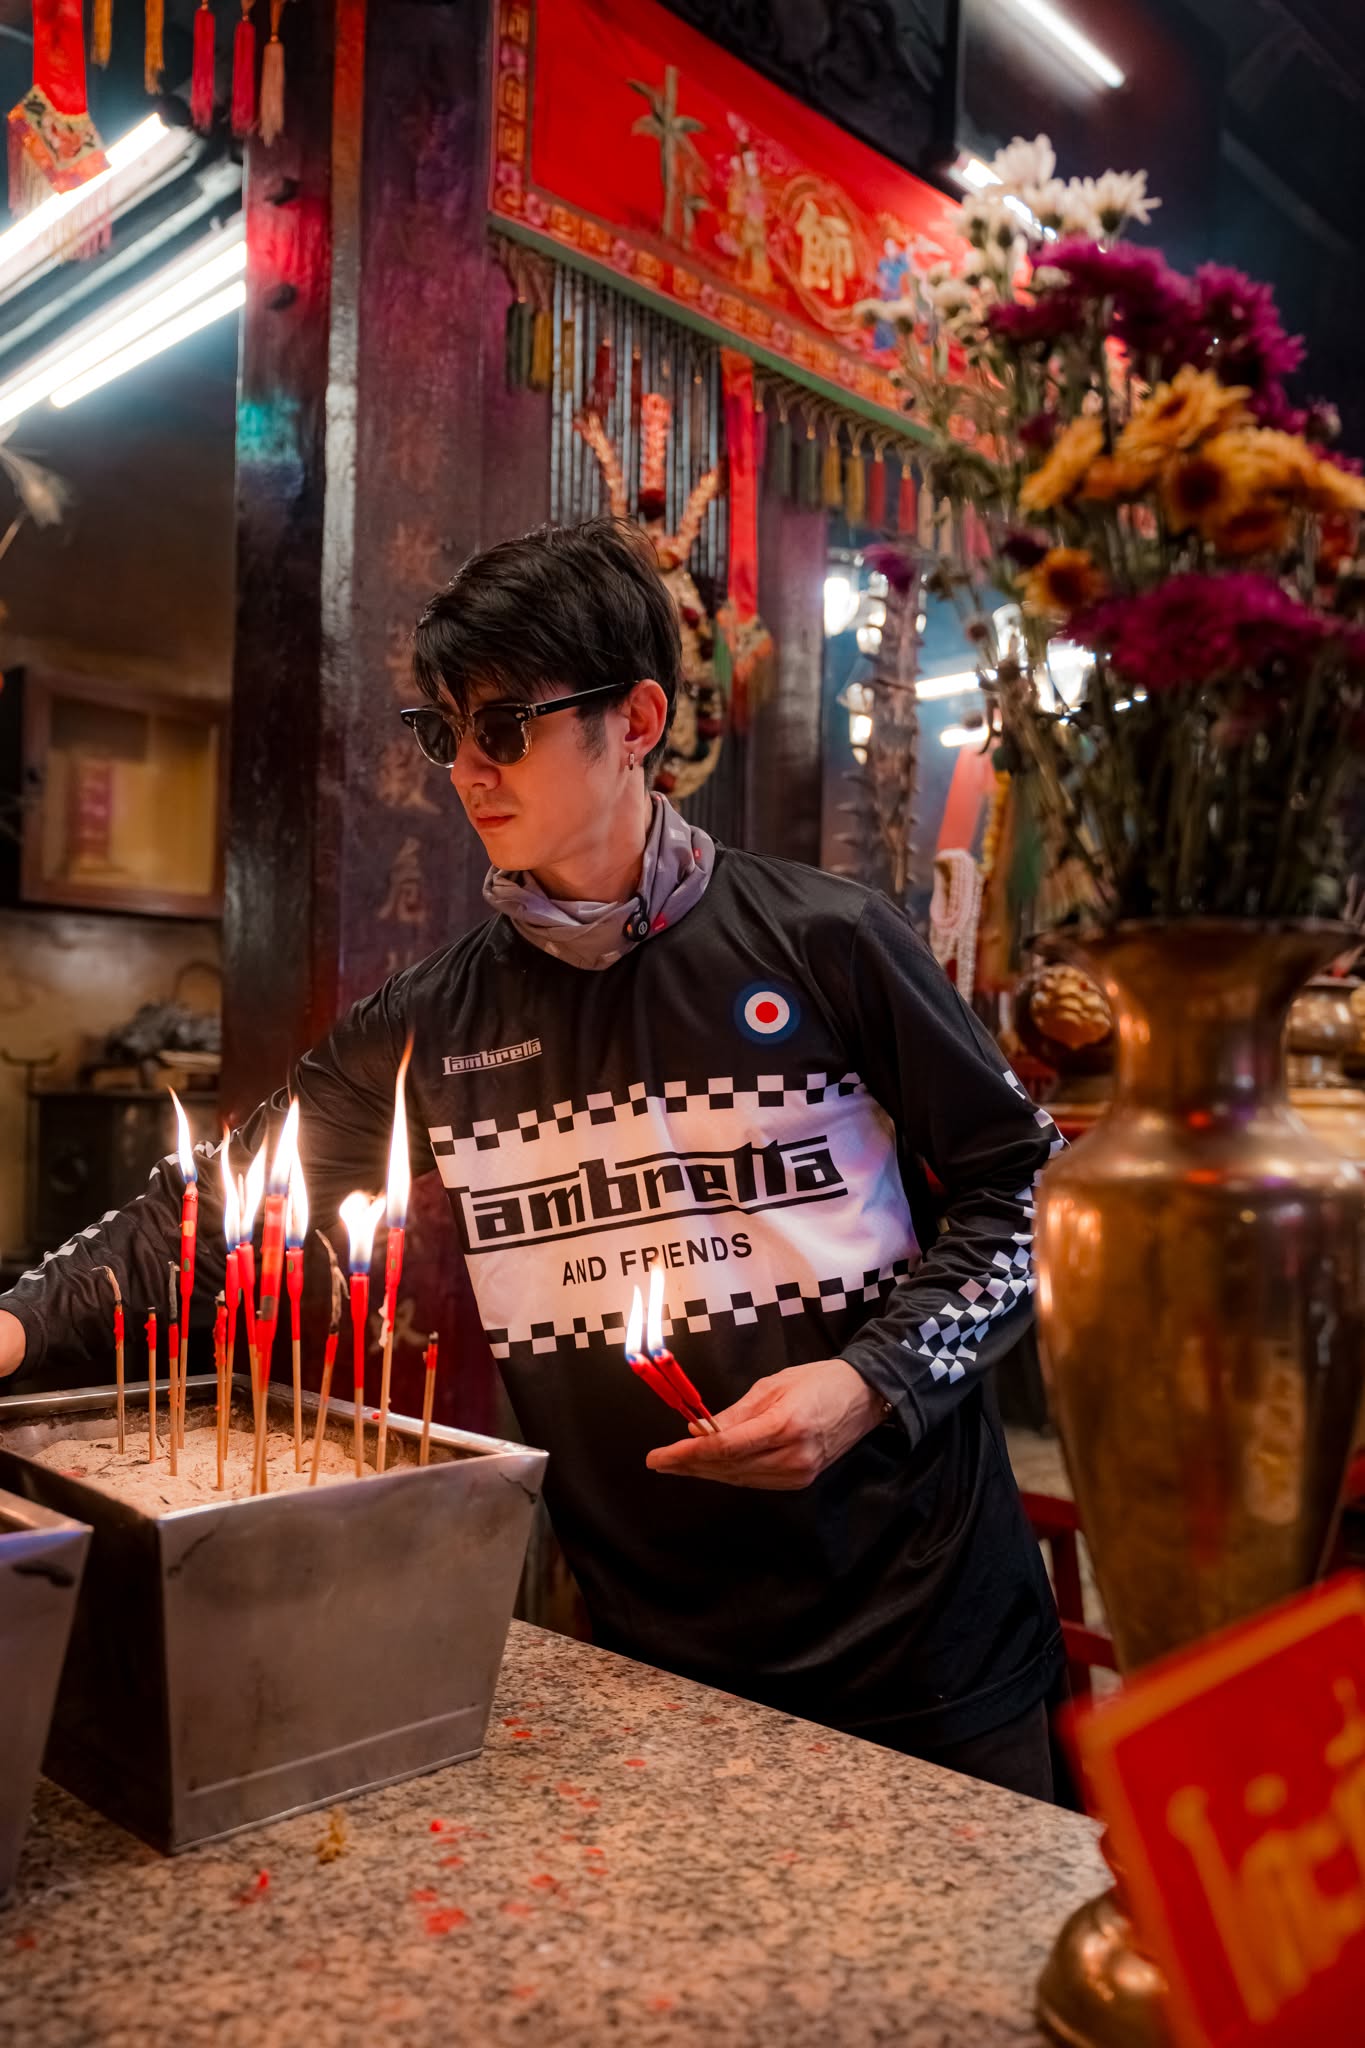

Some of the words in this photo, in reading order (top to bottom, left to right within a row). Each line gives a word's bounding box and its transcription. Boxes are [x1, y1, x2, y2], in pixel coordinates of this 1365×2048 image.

[443, 1038, 543, 1075] Lambretta
[446, 1135, 848, 1255] Lambretta
[562, 1256, 607, 1287] AND
[620, 1232, 752, 1277] FRIENDS
